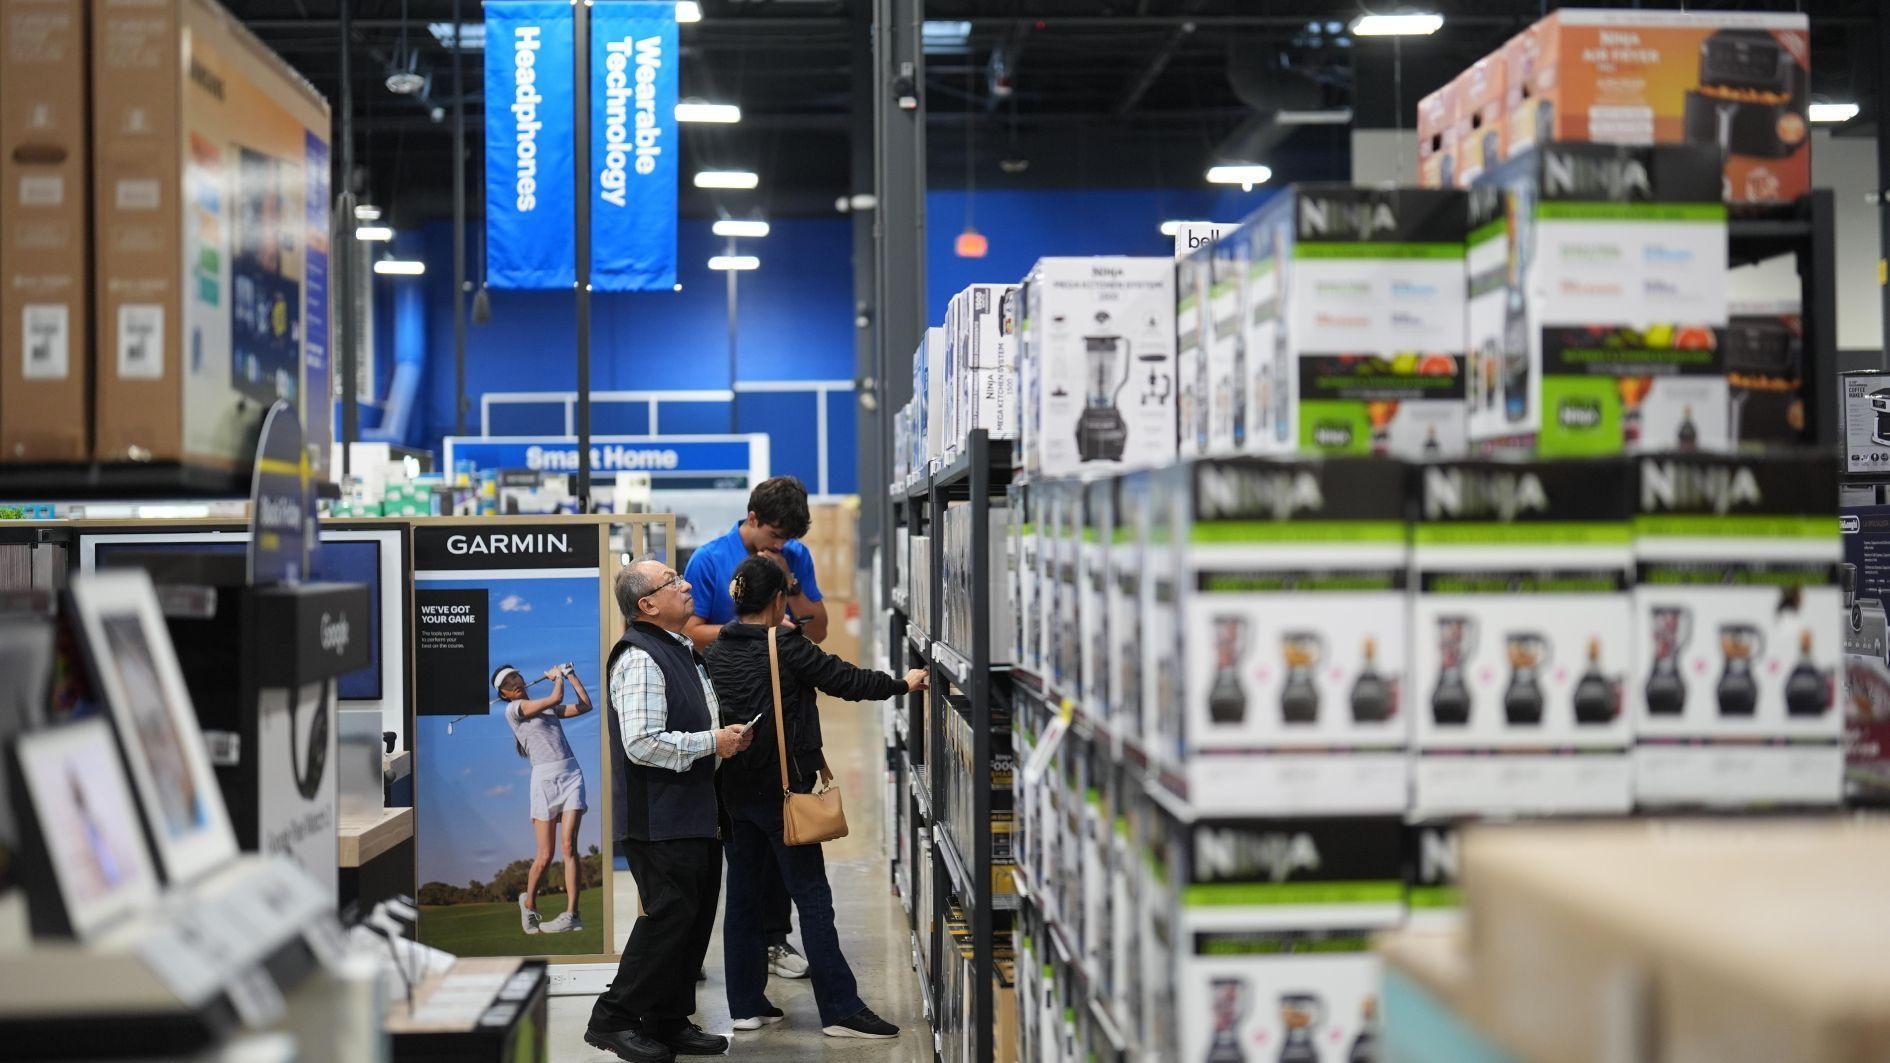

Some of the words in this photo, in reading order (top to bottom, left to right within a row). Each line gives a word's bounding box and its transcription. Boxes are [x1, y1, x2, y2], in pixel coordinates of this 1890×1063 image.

[511, 26, 542, 212] Headphones
[600, 35, 633, 207] Technology
[635, 35, 662, 175] Wearable
[1301, 197, 1397, 240] NINJA
[986, 374, 996, 400] NINJA
[525, 446, 600, 470] Smat
[603, 446, 679, 469] Home
[1199, 464, 1324, 520] NINJA
[1423, 466, 1548, 522] NINJA
[1640, 459, 1761, 515] NINJA
[446, 533, 568, 555] GARMIN
[421, 605, 450, 614] WE'VE
[450, 605, 471, 614] GOT
[421, 615, 447, 624] YOUR
[448, 615, 476, 624] GAME
[1194, 827, 1322, 882] NINJA
